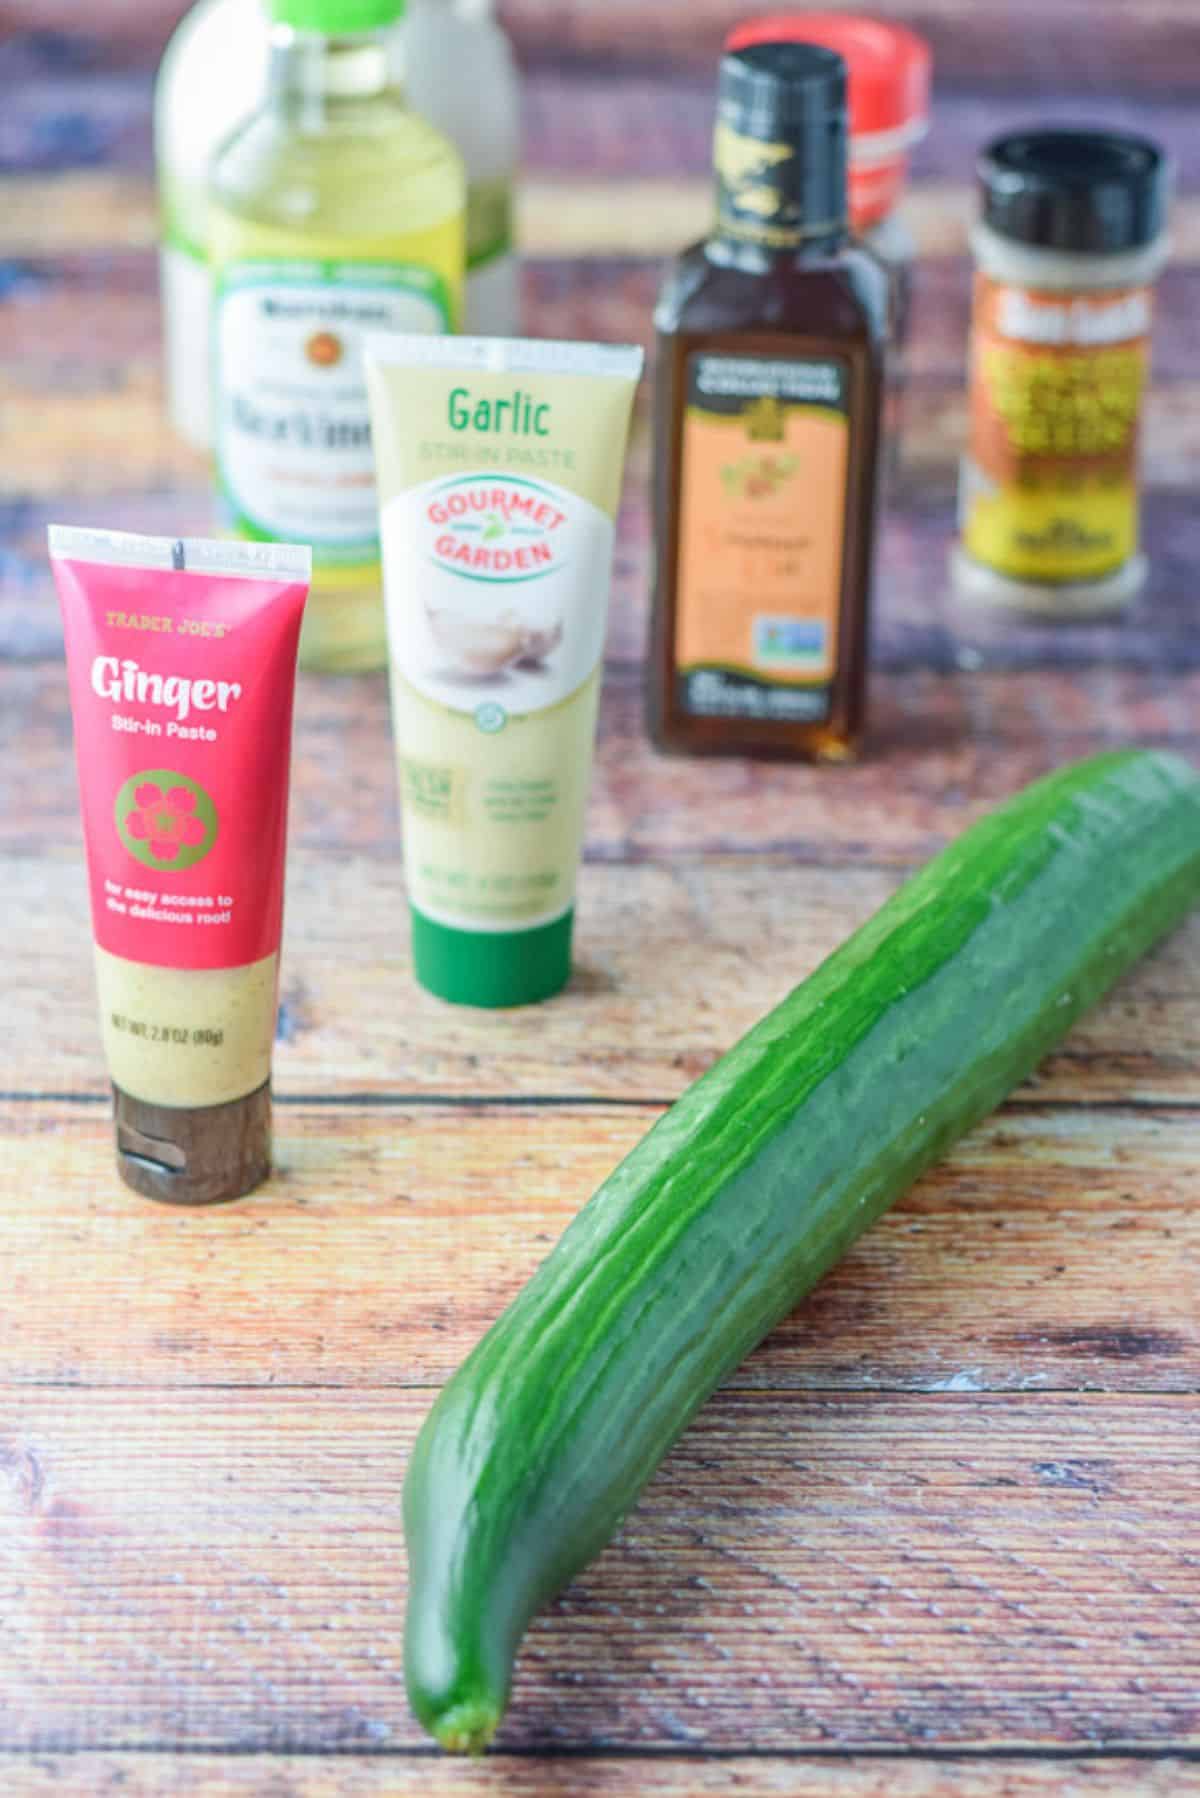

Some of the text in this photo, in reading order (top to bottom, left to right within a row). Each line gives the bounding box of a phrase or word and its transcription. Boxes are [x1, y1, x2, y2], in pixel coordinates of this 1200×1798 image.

[448, 387, 551, 437] Garlic
[505, 449, 577, 470] PASTE
[427, 488, 568, 531] GOURMET
[435, 534, 553, 572] GARDEN
[106, 611, 173, 633] TRADER
[91, 655, 242, 721] Ginger
[166, 721, 218, 742] Paste
[124, 886, 157, 906] easy
[160, 892, 214, 907] access
[217, 895, 233, 907] to
[105, 897, 126, 914] the
[129, 904, 193, 924] delicious
